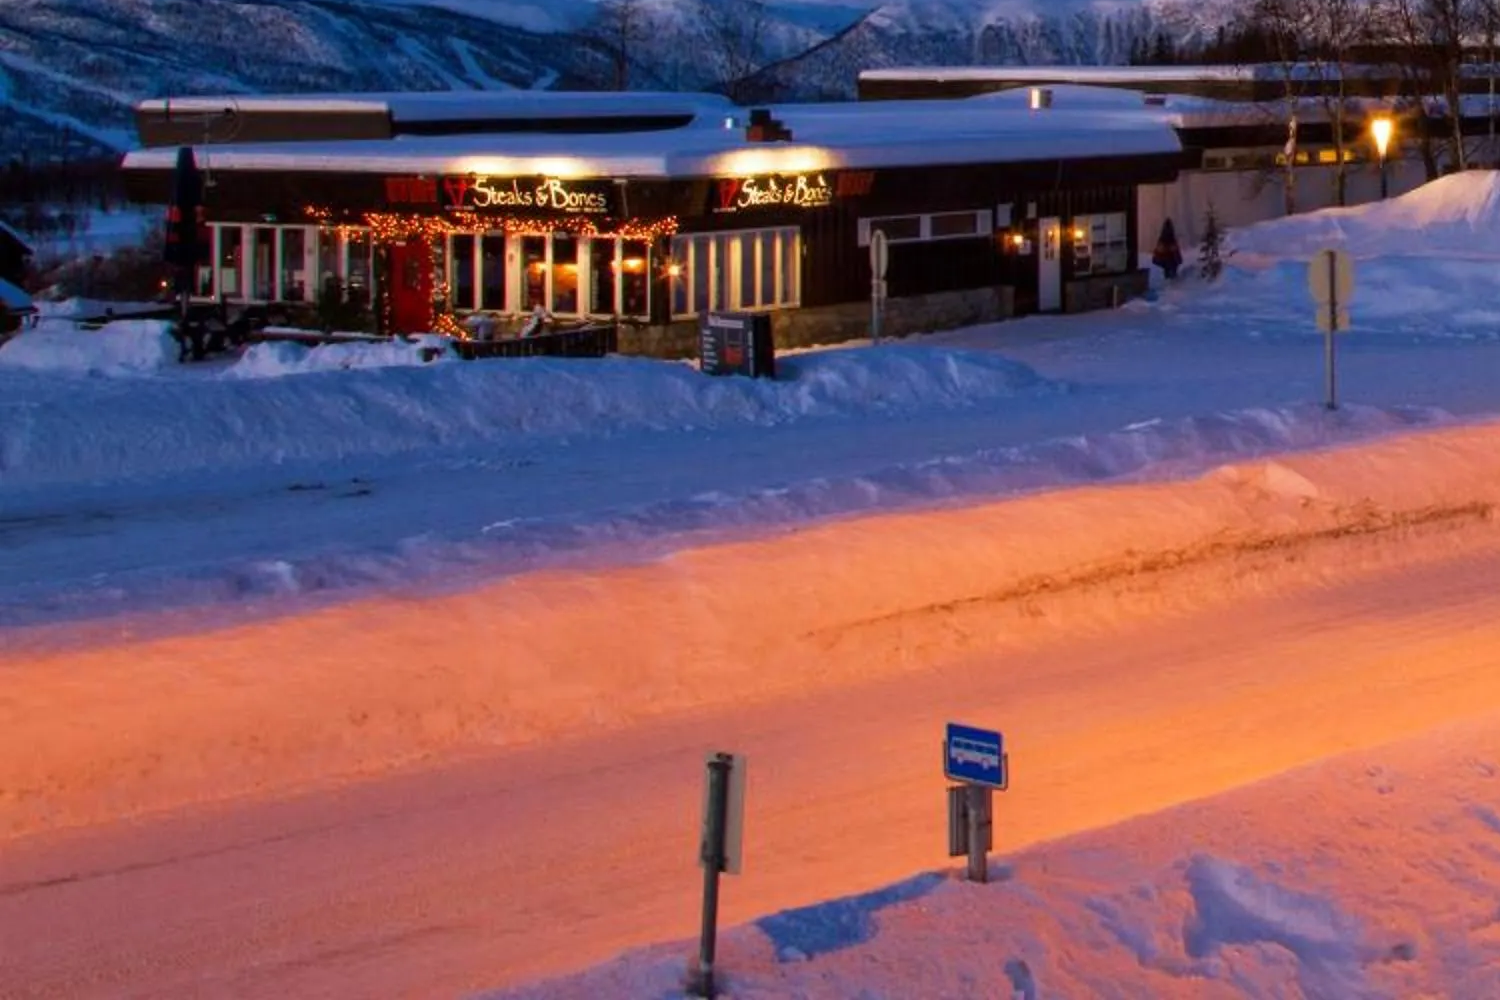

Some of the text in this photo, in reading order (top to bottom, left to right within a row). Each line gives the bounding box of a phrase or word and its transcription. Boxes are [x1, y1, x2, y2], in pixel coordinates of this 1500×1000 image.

[473, 175, 607, 208] Steaks & Bones
[738, 178, 782, 207] Steaks
